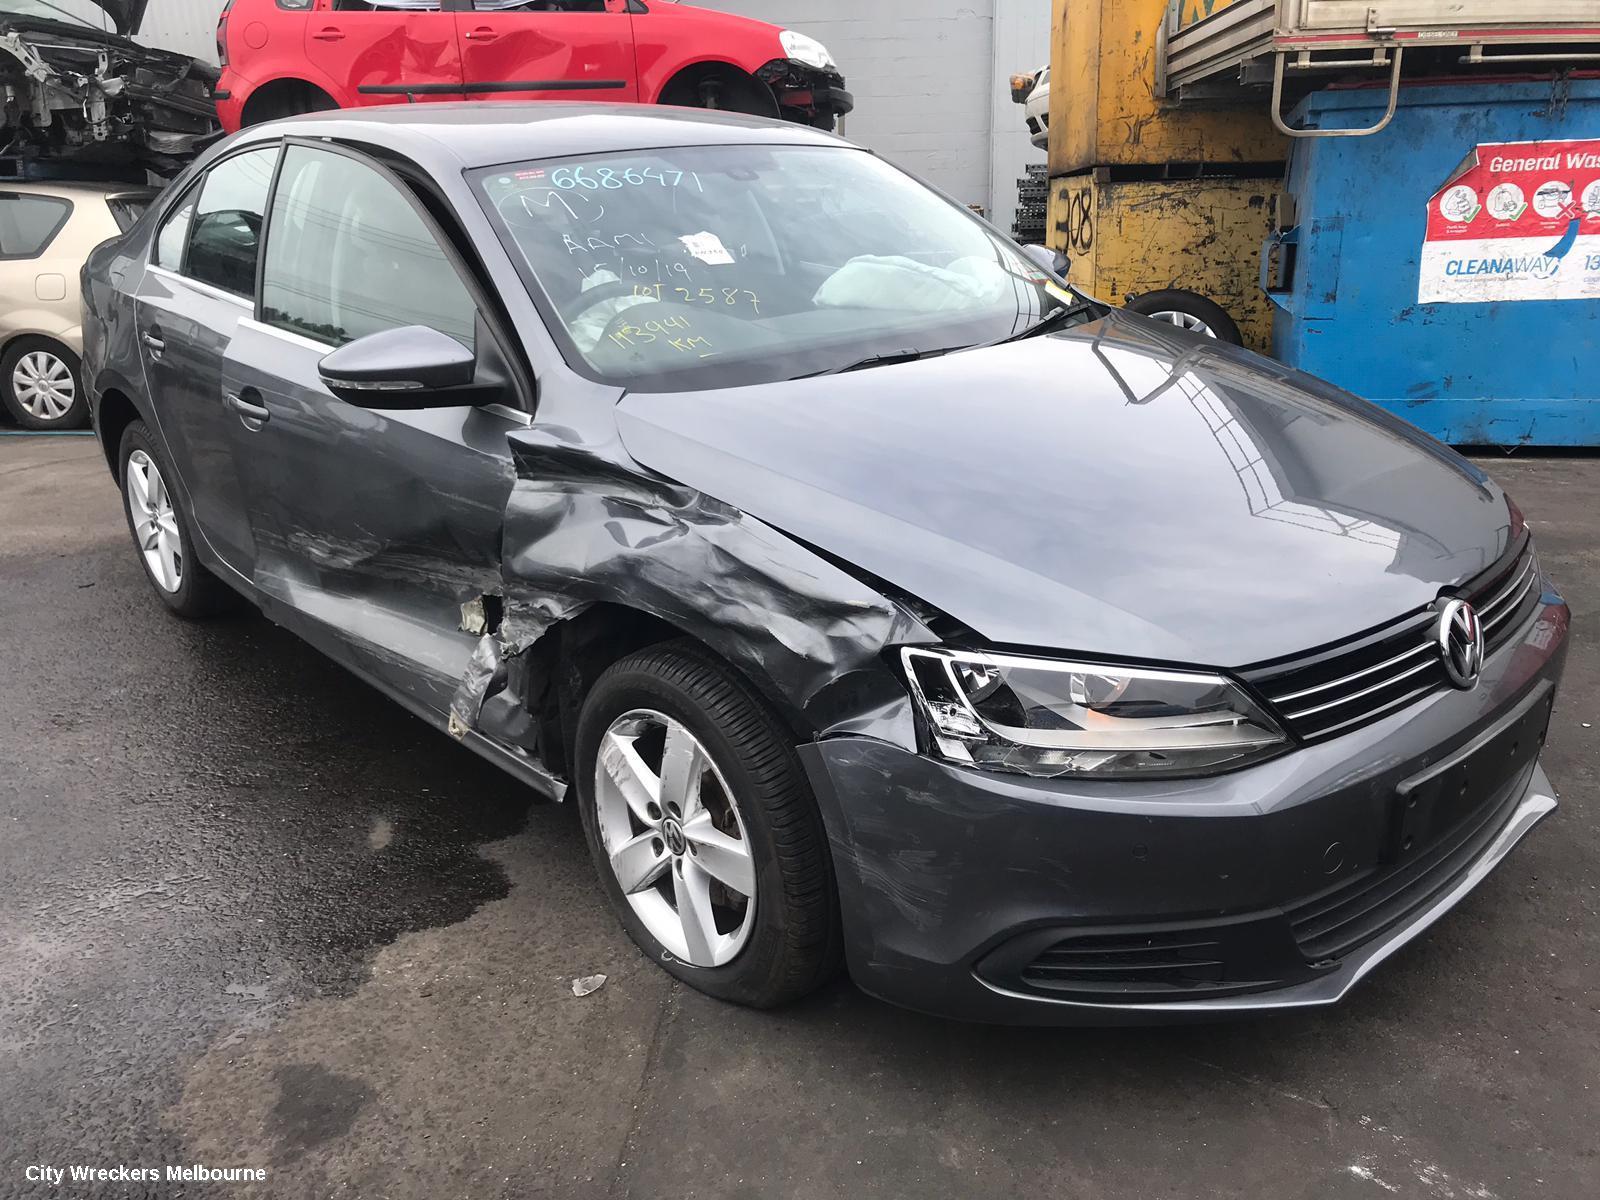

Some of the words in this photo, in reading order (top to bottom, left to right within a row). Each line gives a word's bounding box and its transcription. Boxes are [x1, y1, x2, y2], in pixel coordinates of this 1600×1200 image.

[1489, 153, 1560, 172] General
[552, 166, 703, 192] 6686471
[1445, 256, 1554, 276] CLEANAWAY
[675, 287, 761, 314] 2587
